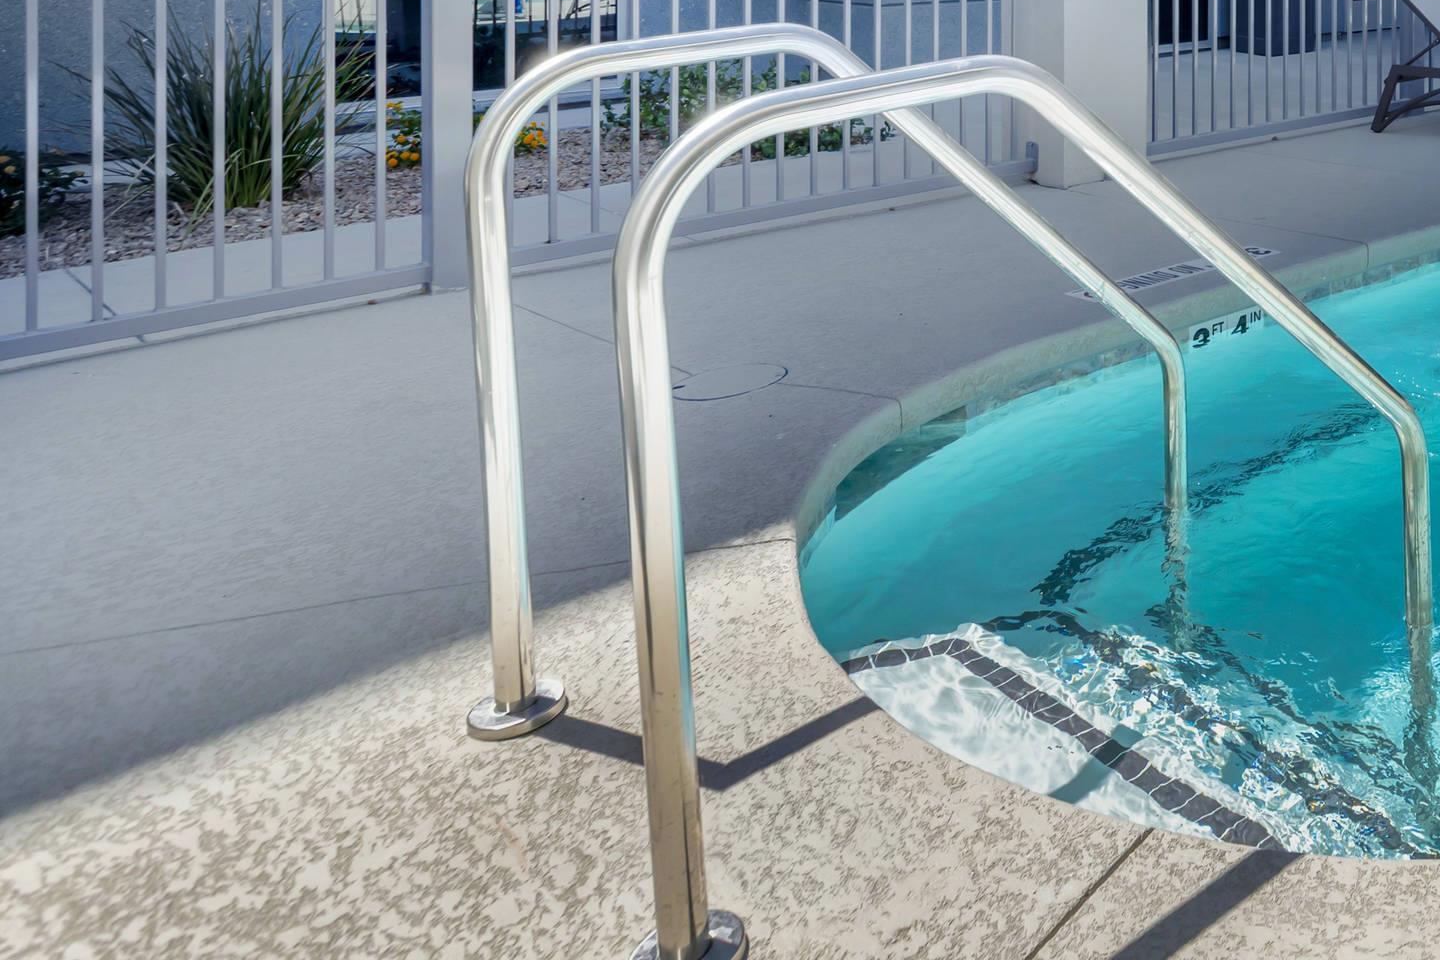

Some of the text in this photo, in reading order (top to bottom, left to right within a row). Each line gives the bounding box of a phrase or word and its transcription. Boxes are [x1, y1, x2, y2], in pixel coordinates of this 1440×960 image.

[1177, 263, 1204, 276] NO
[1192, 310, 1262, 349] 3 FT 4 IN
